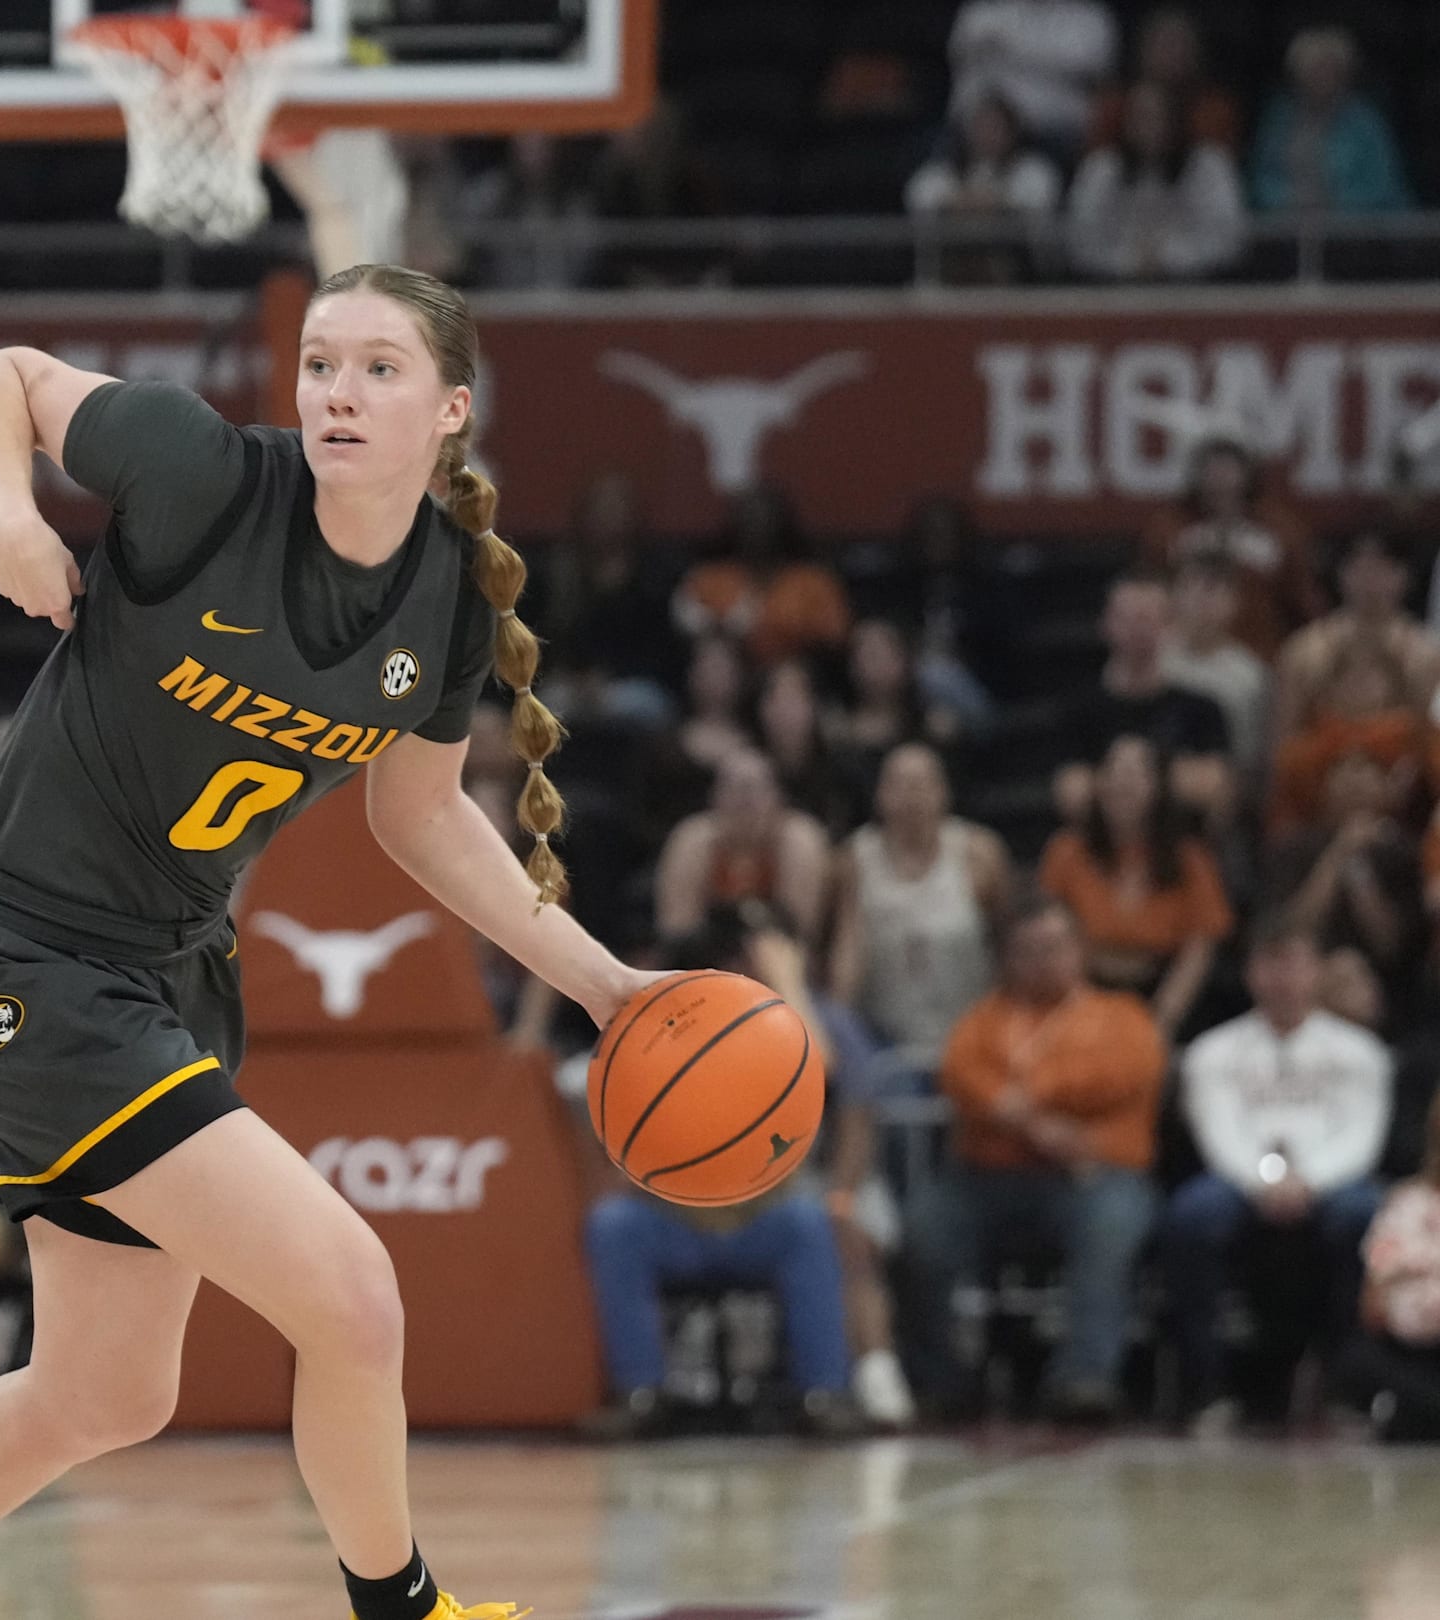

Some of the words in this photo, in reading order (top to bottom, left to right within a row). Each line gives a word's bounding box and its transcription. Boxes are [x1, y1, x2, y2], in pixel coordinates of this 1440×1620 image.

[157, 655, 400, 764] MIZZOU
[383, 652, 417, 697] SEC
[168, 759, 305, 852] 0
